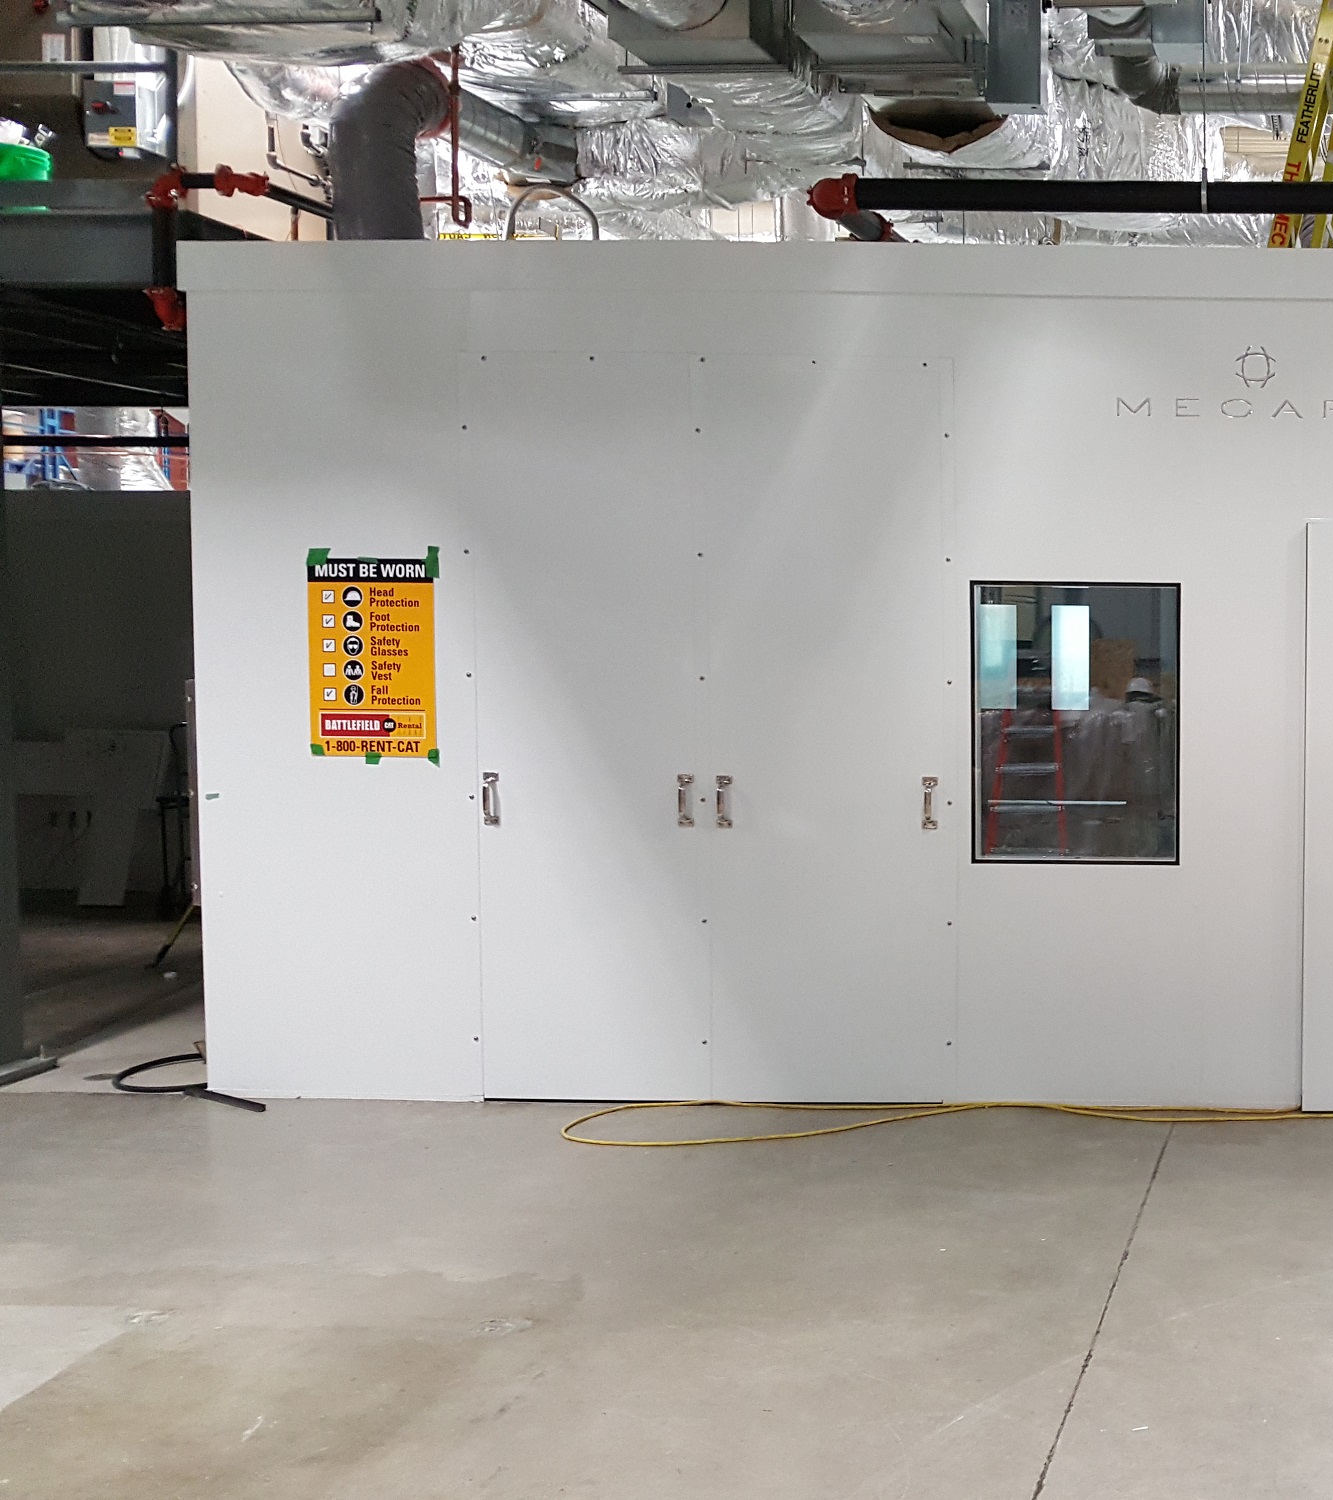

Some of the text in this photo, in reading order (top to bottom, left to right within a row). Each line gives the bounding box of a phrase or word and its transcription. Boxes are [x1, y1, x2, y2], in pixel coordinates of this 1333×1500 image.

[314, 563, 426, 578] MUST BE WORN
[369, 587, 394, 597] Head
[369, 597, 420, 608] Protection
[370, 611, 391, 622] Foot
[370, 622, 420, 632] Protection
[370, 636, 401, 648] Safety
[370, 646, 409, 656] Glasses
[371, 660, 402, 672] Safety
[371, 671, 393, 681] Vest
[371, 685, 389, 695] Fall
[371, 695, 421, 706] Protection
[325, 720, 422, 731] BATTLEFIELD CAT Rental
[325, 740, 420, 753] 1-800-RENT-CAT
